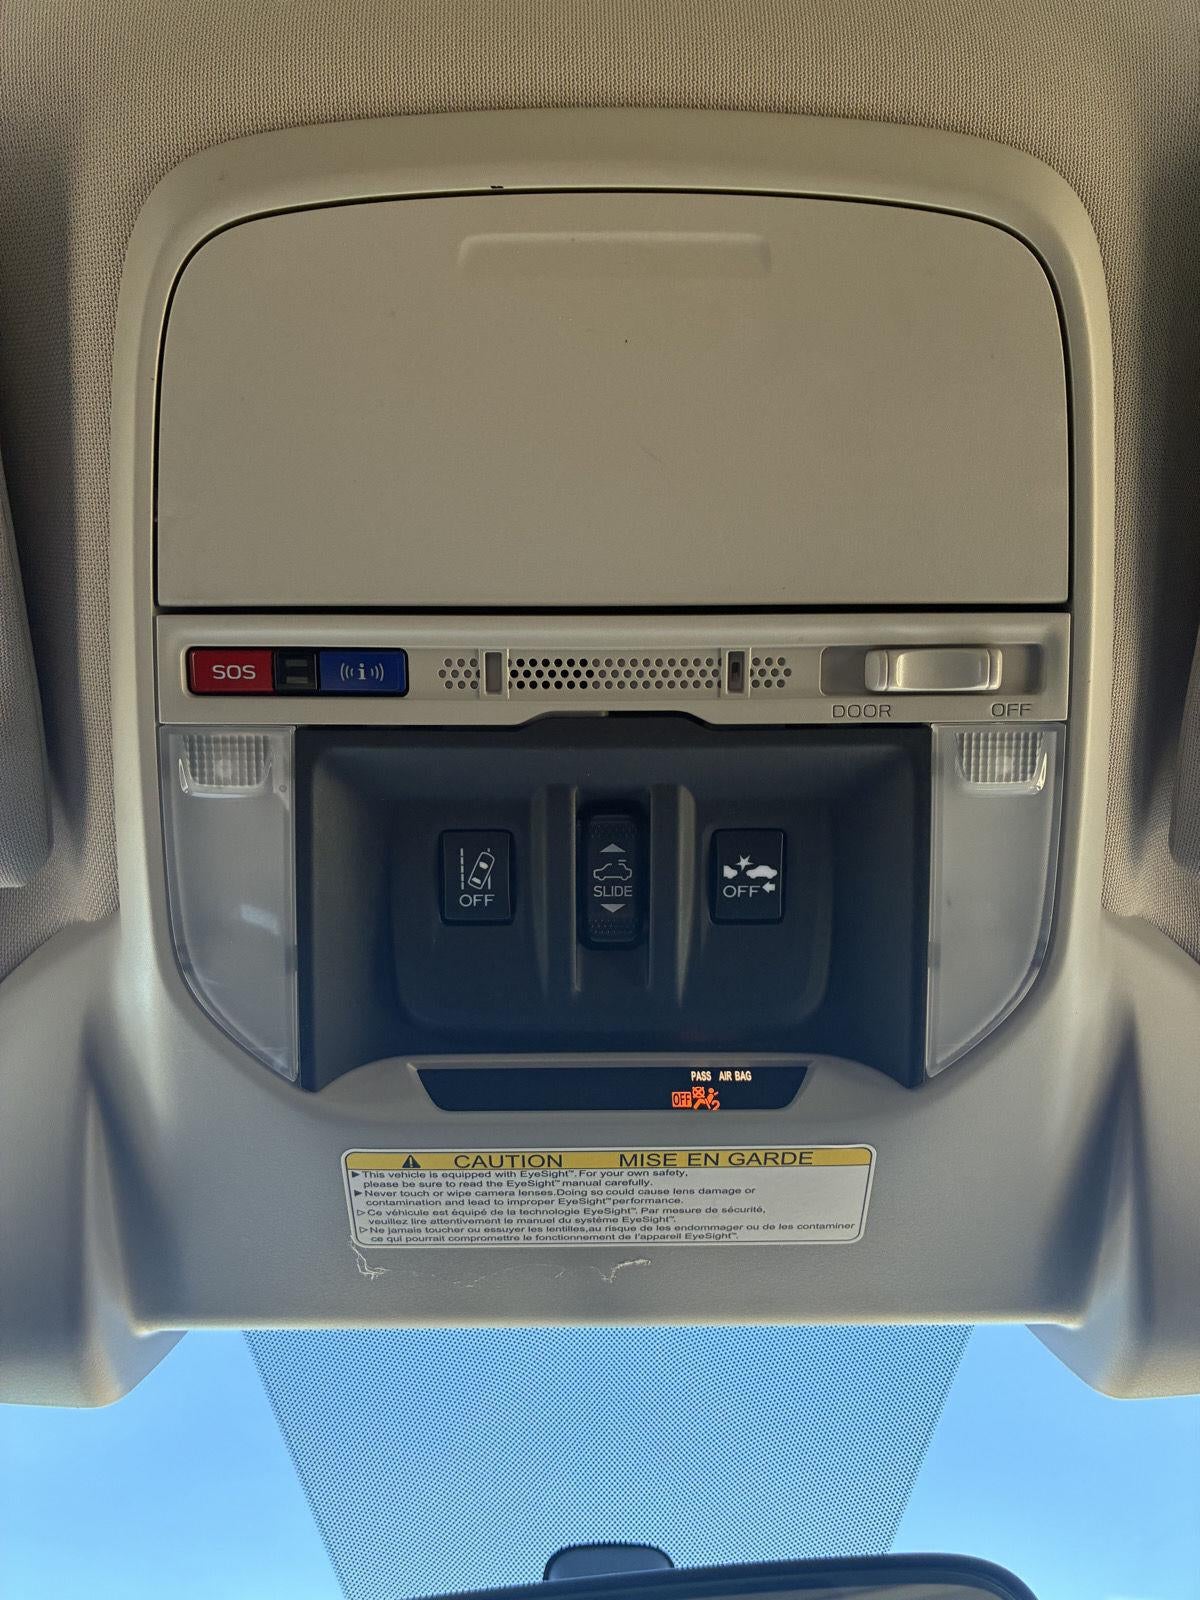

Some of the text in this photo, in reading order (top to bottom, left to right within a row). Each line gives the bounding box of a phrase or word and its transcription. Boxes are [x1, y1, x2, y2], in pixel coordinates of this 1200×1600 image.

[212, 664, 256, 680] SOS
[832, 704, 891, 718] DOOR
[991, 703, 1032, 717] OFF
[593, 885, 633, 897] SLIDE
[723, 885, 761, 898] OFF
[459, 894, 495, 907] OFF
[691, 1071, 752, 1081] PASS AIR BAG
[673, 1093, 691, 1106] OFF
[454, 1154, 563, 1169] CAUTION
[619, 1151, 814, 1167] MISE EN GARDE
[441, 1171, 491, 1180] equipped
[495, 1170, 516, 1178] with
[600, 1170, 624, 1178] your
[363, 1181, 399, 1189] please
[402, 1180, 416, 1188] be
[459, 1180, 483, 1188] read
[605, 1179, 653, 1187] carefully.
[446, 1190, 472, 1198] wipe
[605, 1188, 635, 1196] could
[698, 1187, 742, 1196] damage
[468, 1198, 491, 1206] lead
[507, 1198, 555, 1207] improper
[612, 1197, 684, 1206] performance.
[386, 1208, 430, 1216] véhicule
[433, 1208, 449, 1216] est
[451, 1208, 488, 1217] équipé
[490, 1208, 504, 1216] de
[507, 1208, 516, 1216] la
[520, 1208, 580, 1217] technologie
[705, 1206, 718, 1214] de
[721, 1205, 766, 1214] sécurité,
[430, 1217, 501, 1225] attentivement
[575, 1216, 619, 1225] système
[388, 1226, 422, 1235] jamais
[483, 1226, 525, 1234] essuyer
[604, 1225, 637, 1233] risque
[674, 1224, 743, 1232] endommager
[797, 1222, 855, 1230] contaminer
[386, 1235, 403, 1243] qui
[405, 1235, 445, 1243] pourrait
[448, 1234, 520, 1242] compromettre
[535, 1233, 615, 1241] fonctionnement
[634, 1232, 682, 1241] l'appareil
